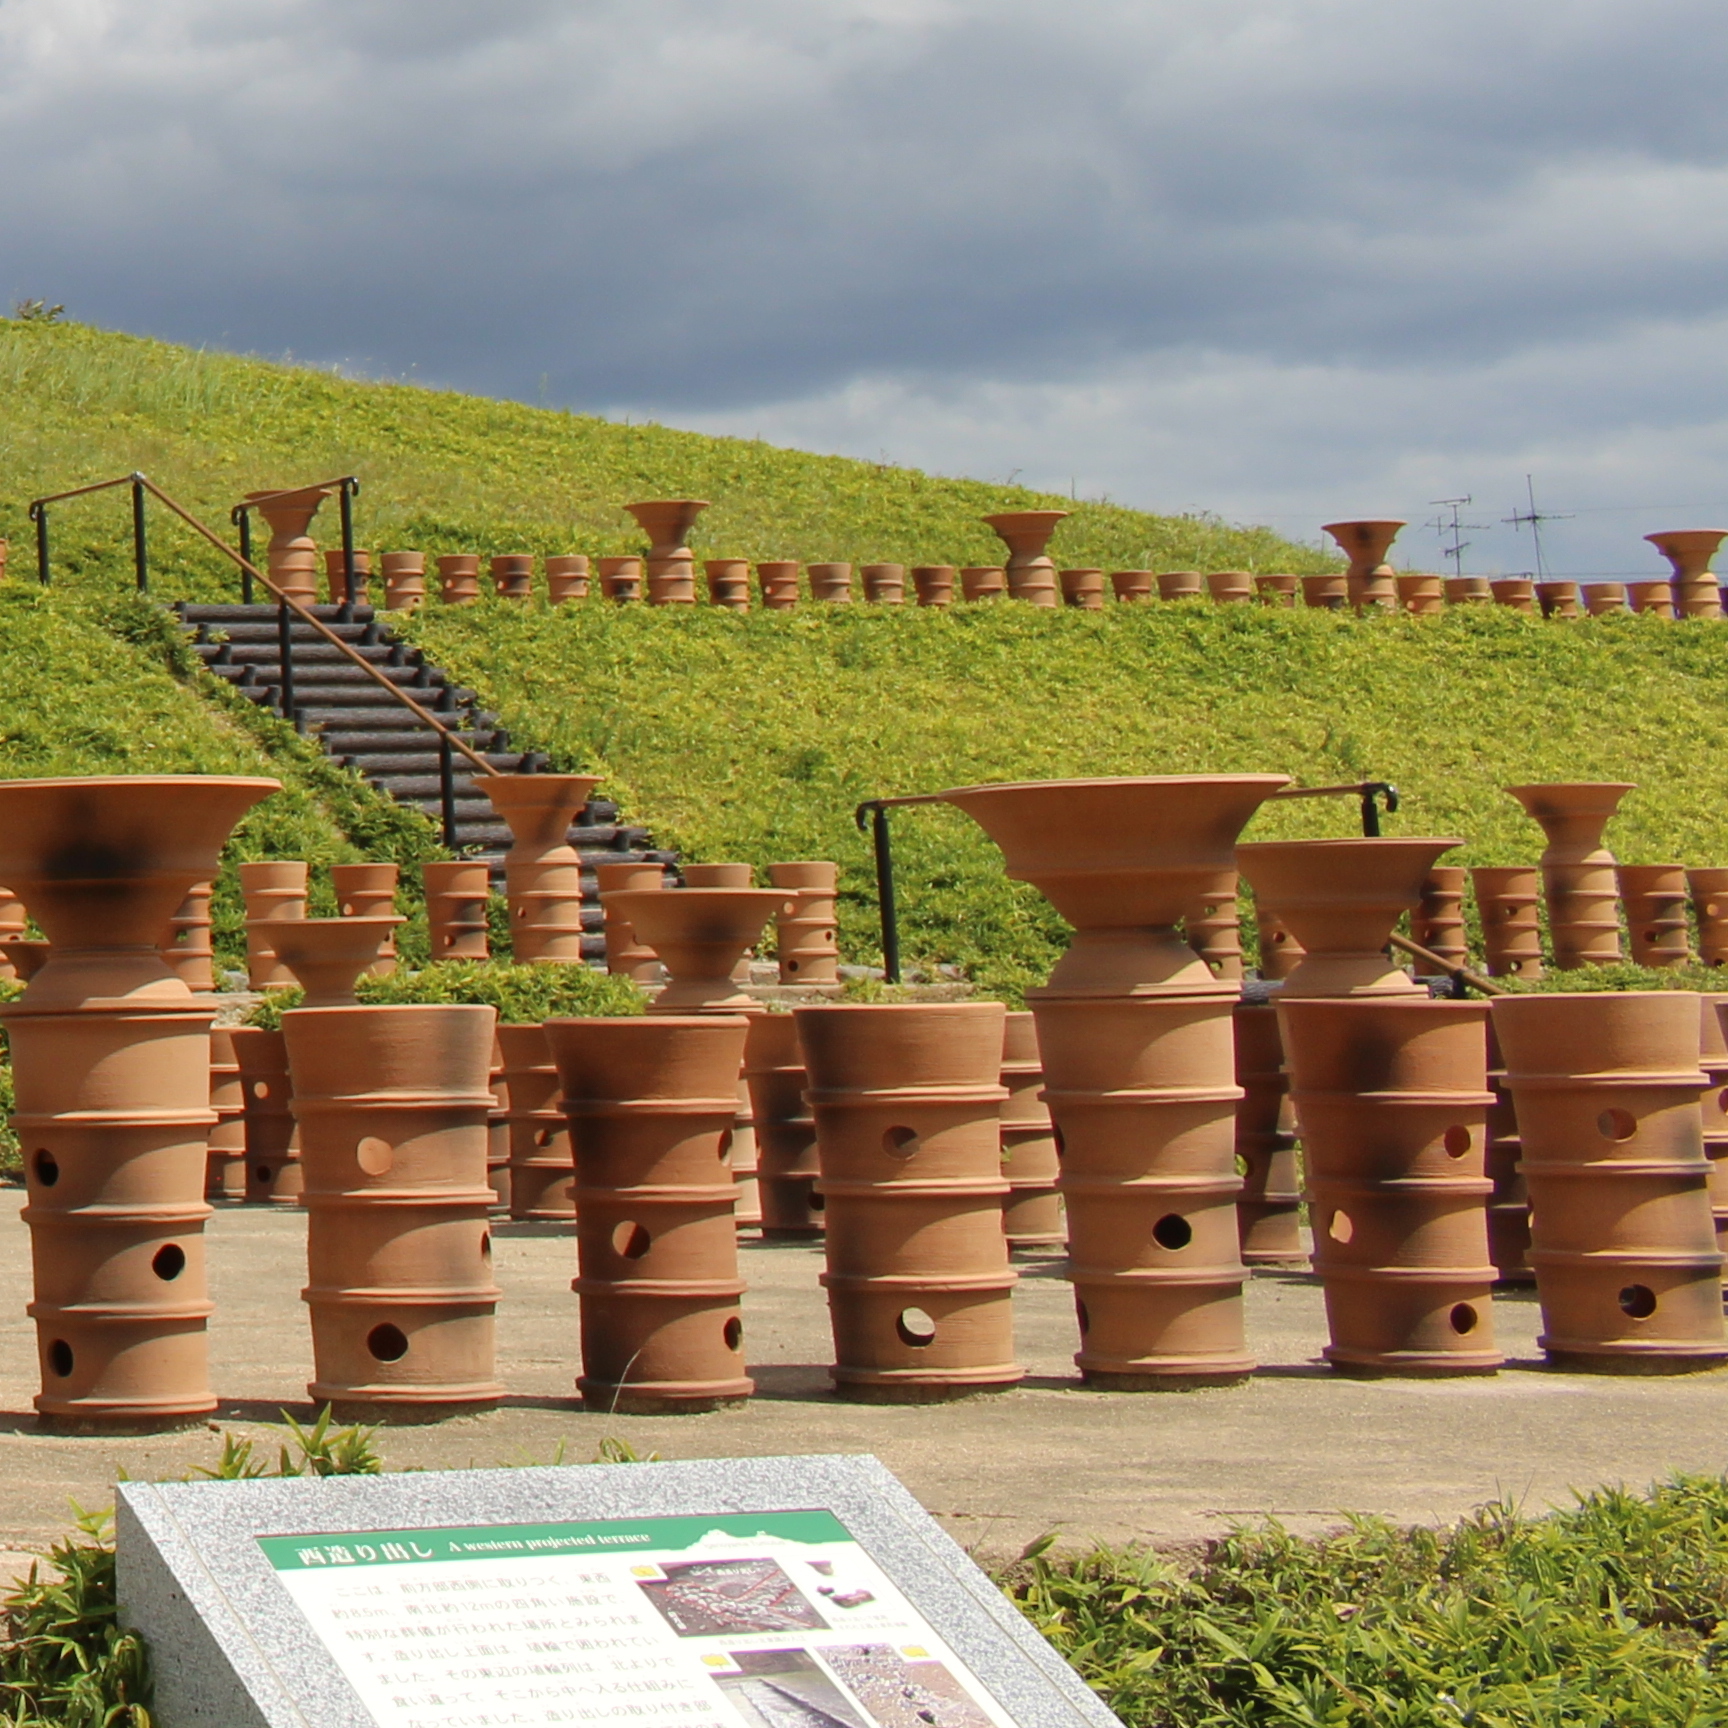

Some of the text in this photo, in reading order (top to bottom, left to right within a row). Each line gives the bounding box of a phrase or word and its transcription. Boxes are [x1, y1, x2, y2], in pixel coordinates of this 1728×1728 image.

[294, 1541, 434, 1566] 西造り出し
[448, 1533, 652, 1553] A western projected terrace
